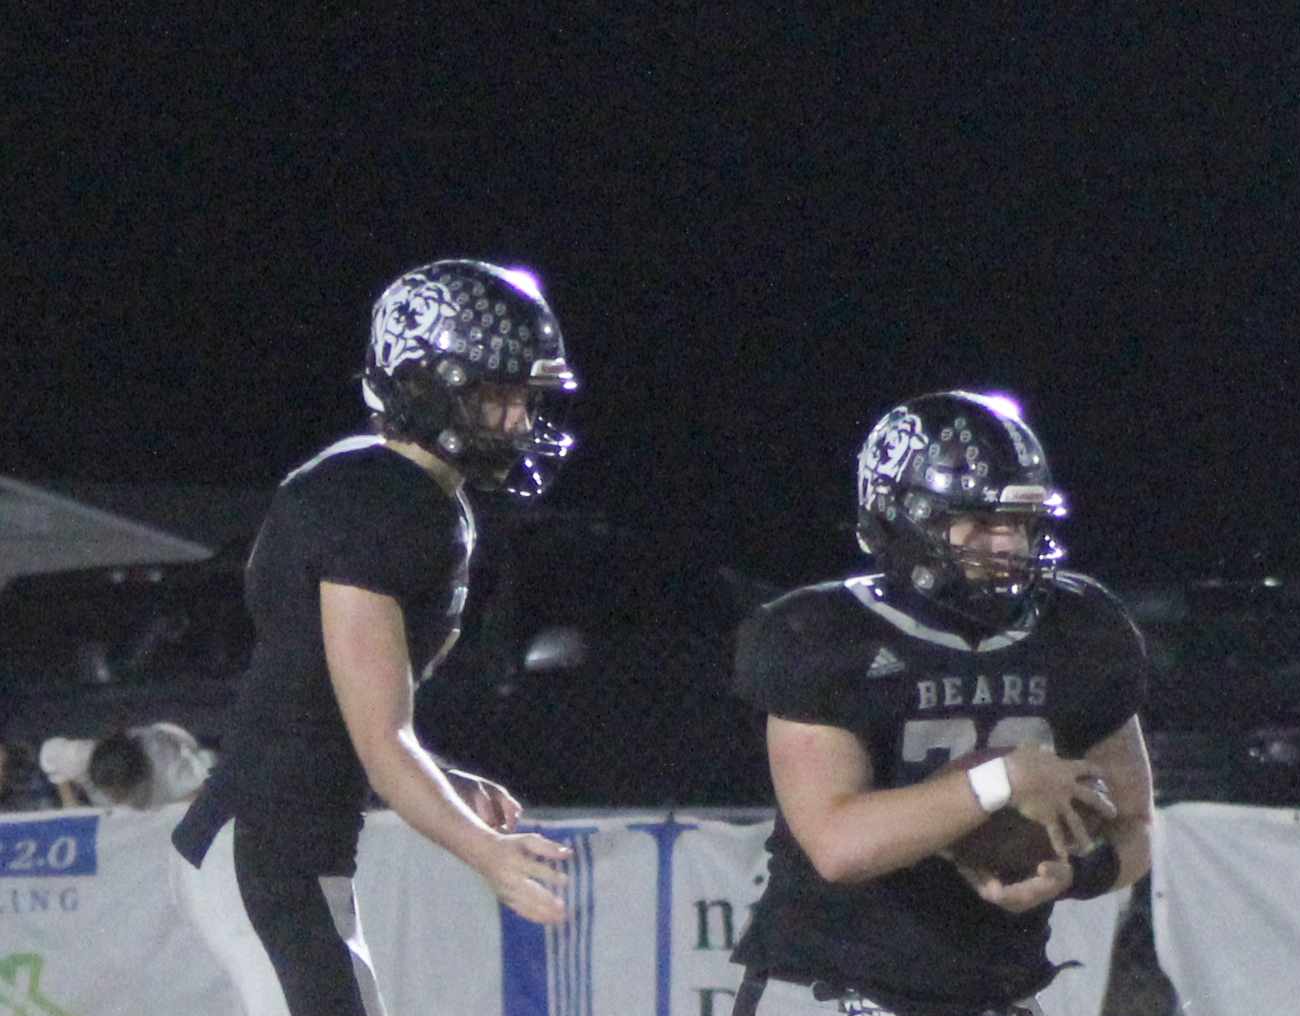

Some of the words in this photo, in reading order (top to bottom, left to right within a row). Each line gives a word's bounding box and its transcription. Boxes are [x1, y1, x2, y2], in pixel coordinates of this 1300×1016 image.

[918, 674, 1048, 709] BEARS
[8, 836, 77, 871] 2.0
[0, 887, 80, 914] ING
